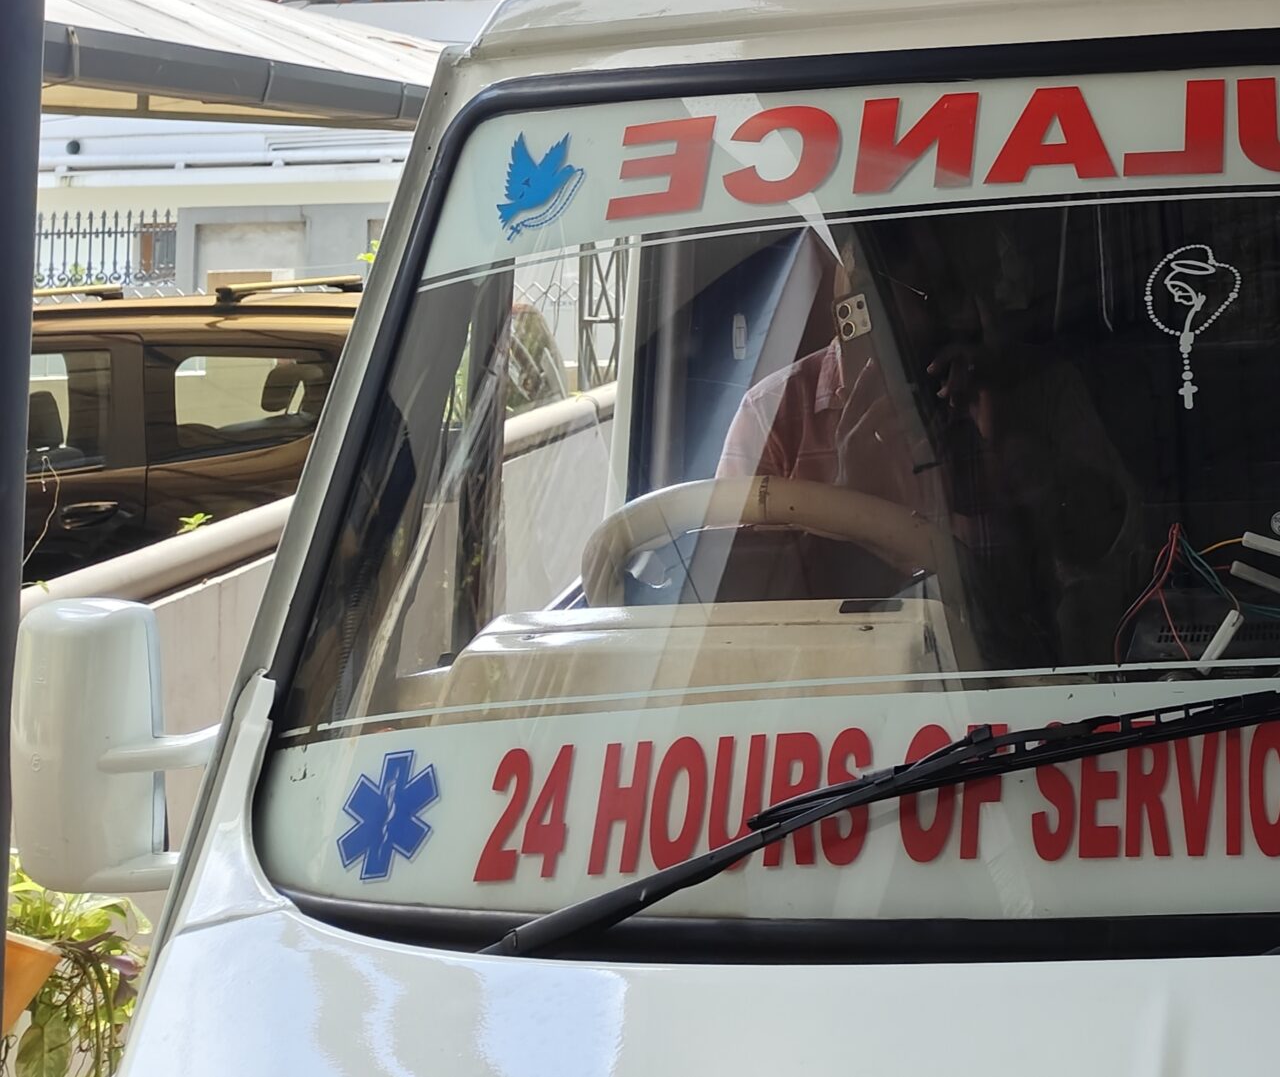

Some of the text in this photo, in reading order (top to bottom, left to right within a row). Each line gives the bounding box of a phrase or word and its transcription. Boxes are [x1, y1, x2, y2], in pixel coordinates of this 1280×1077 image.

[474, 744, 574, 882] 24
[588, 727, 872, 876] HOURS
[900, 724, 1010, 862] OF
